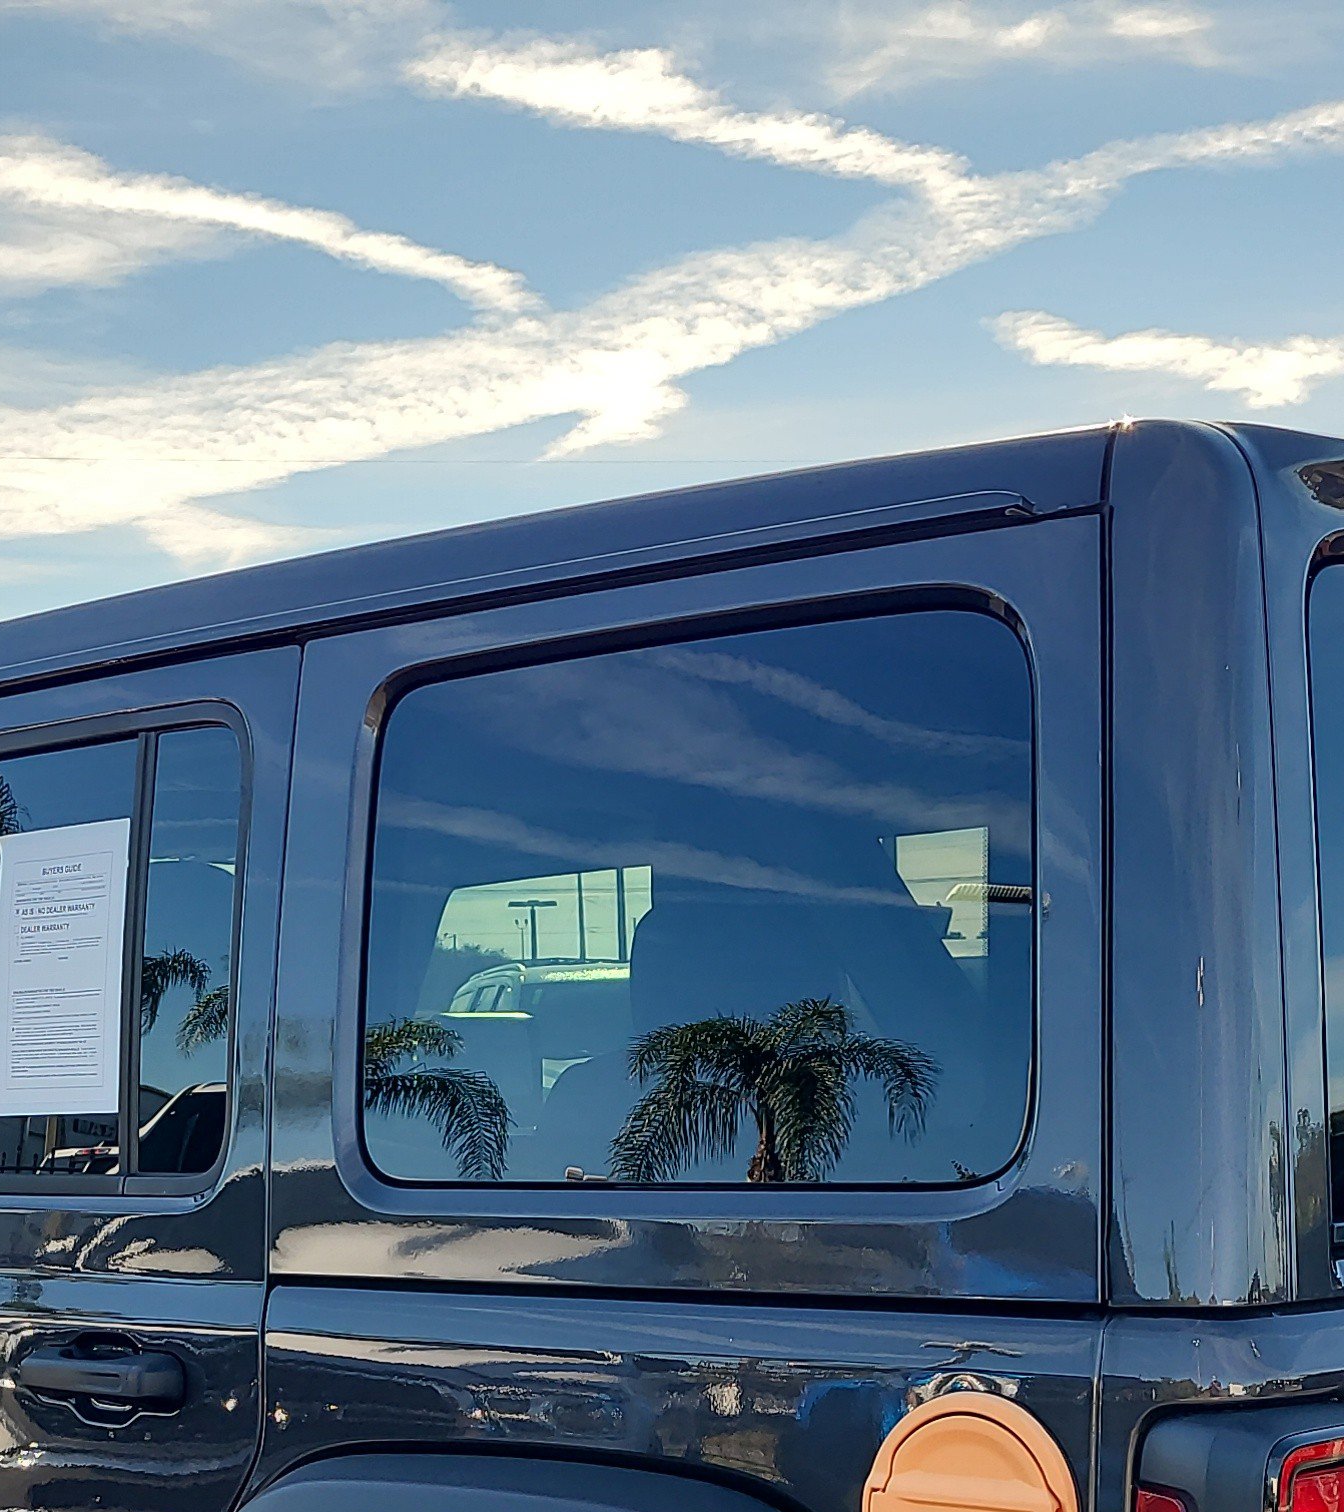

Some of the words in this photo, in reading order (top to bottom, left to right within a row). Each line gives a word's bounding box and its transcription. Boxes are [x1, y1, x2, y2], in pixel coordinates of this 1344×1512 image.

[42, 866, 64, 876] BUYERS
[65, 863, 82, 873] GUIDE
[46, 905, 66, 914] DEALER
[67, 903, 96, 912] WARRANTY
[21, 925, 40, 934] DEALER
[42, 923, 69, 932] WARRANTY
